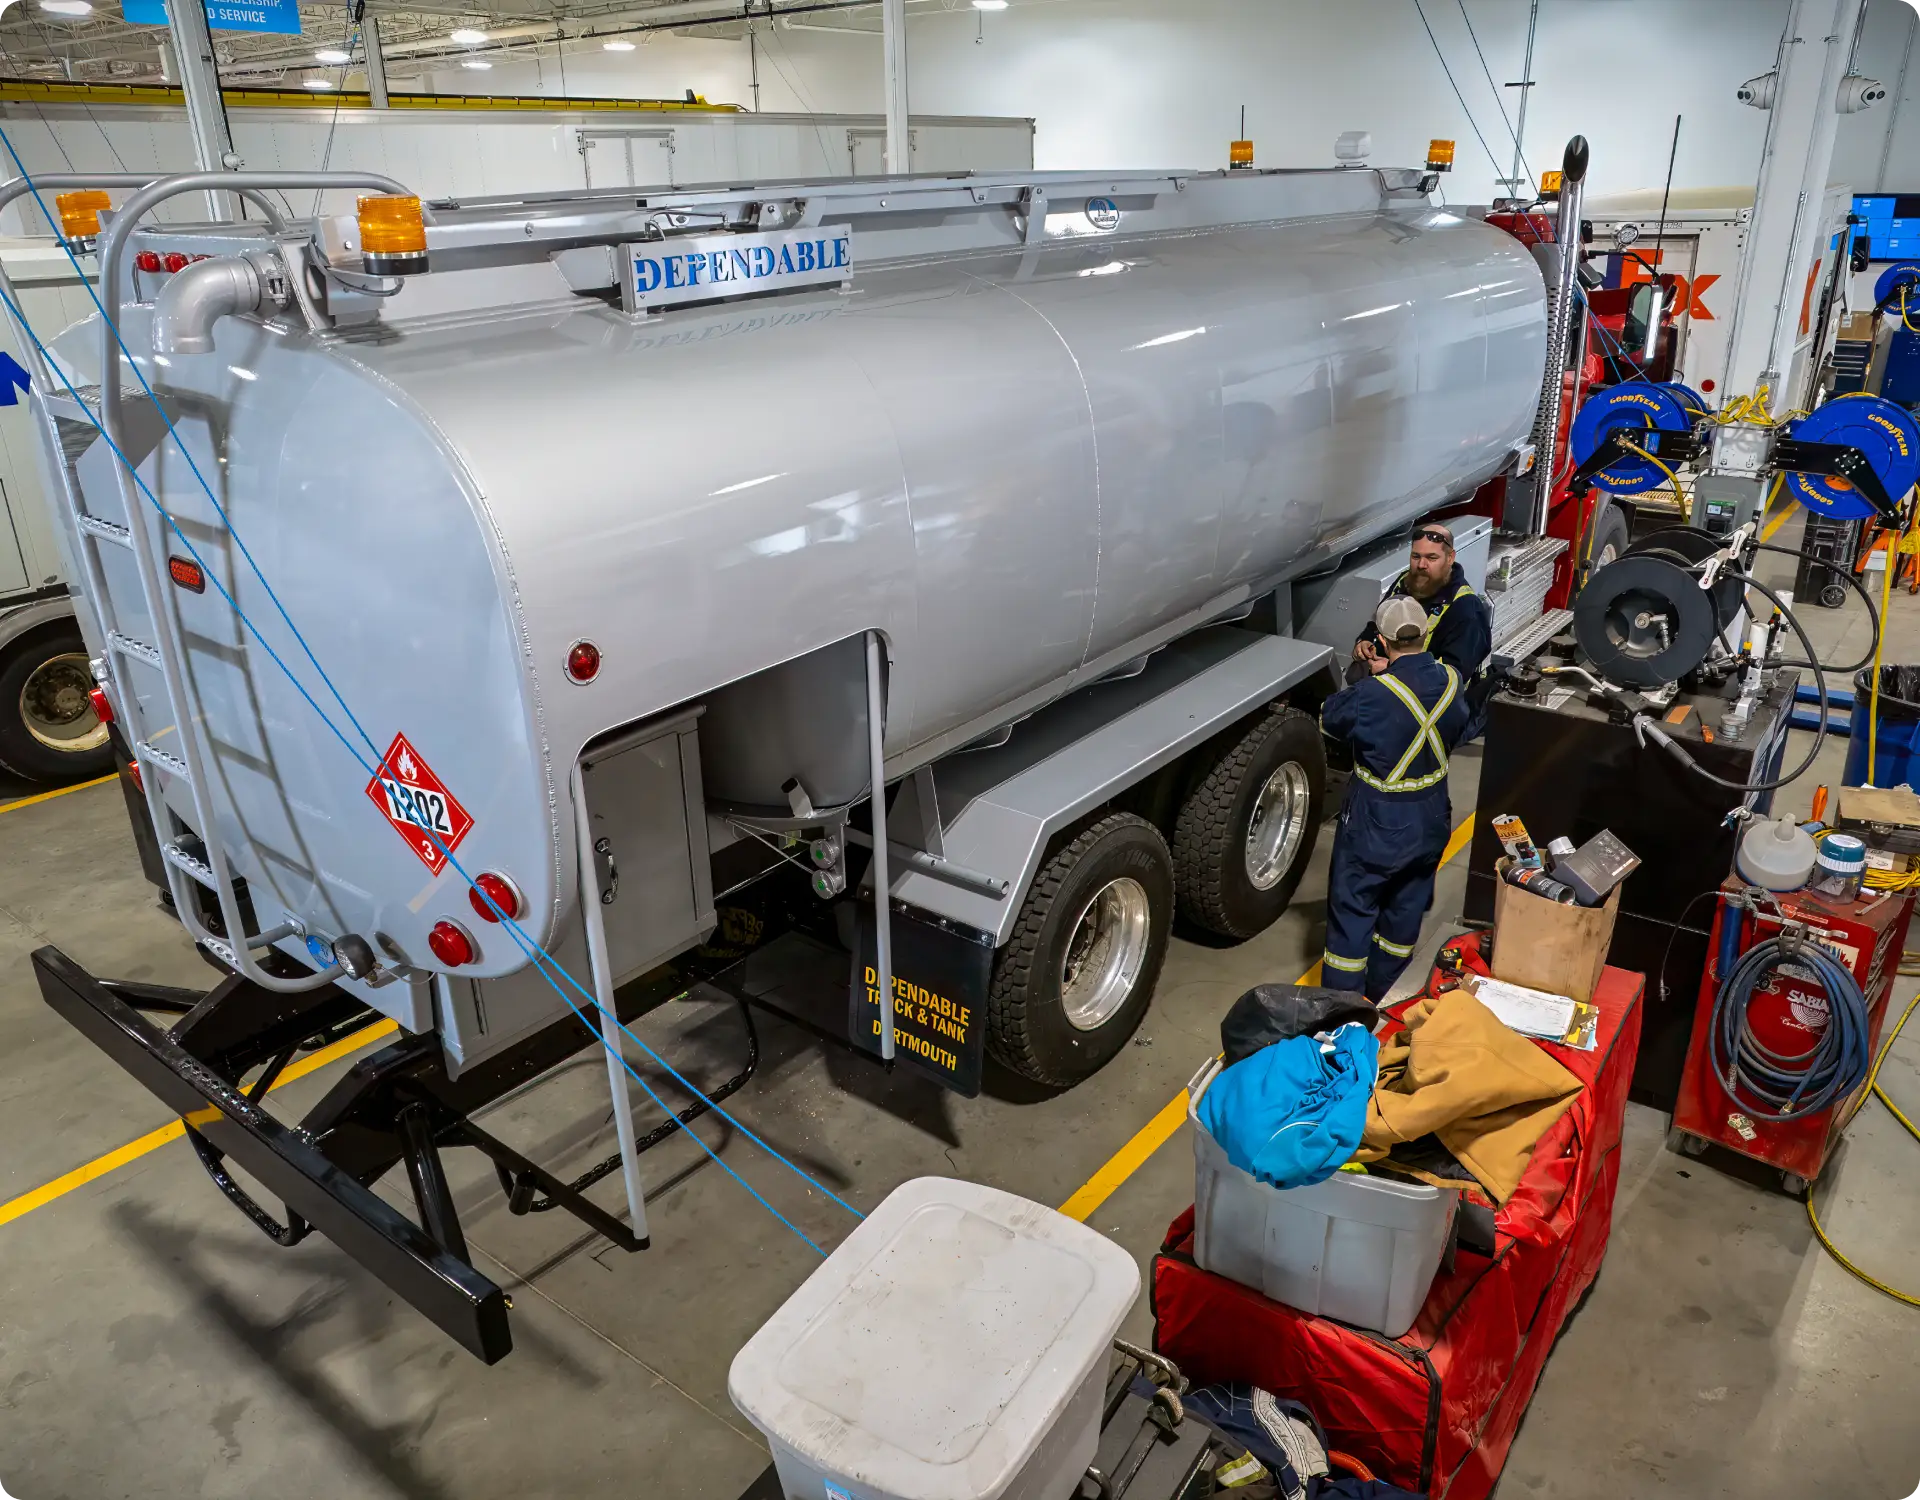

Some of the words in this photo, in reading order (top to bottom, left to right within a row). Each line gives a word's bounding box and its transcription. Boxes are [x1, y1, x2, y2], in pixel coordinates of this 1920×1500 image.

[219, 8, 267, 23] SERVICE
[633, 237, 851, 293] DEPENDABLE
[1609, 394, 1661, 412] GOODYEAR
[1867, 413, 1909, 457] GOODYEAR
[388, 782, 449, 832] 1202
[421, 840, 436, 861] 3
[864, 966, 971, 1027] DPENDABLE
[866, 987, 914, 1019] TRCK
[917, 1008, 928, 1026] &
[931, 1013, 966, 1044] TANK
[1786, 989, 1829, 1013] SABIA
[872, 1019, 957, 1071] DRTMOUTH
